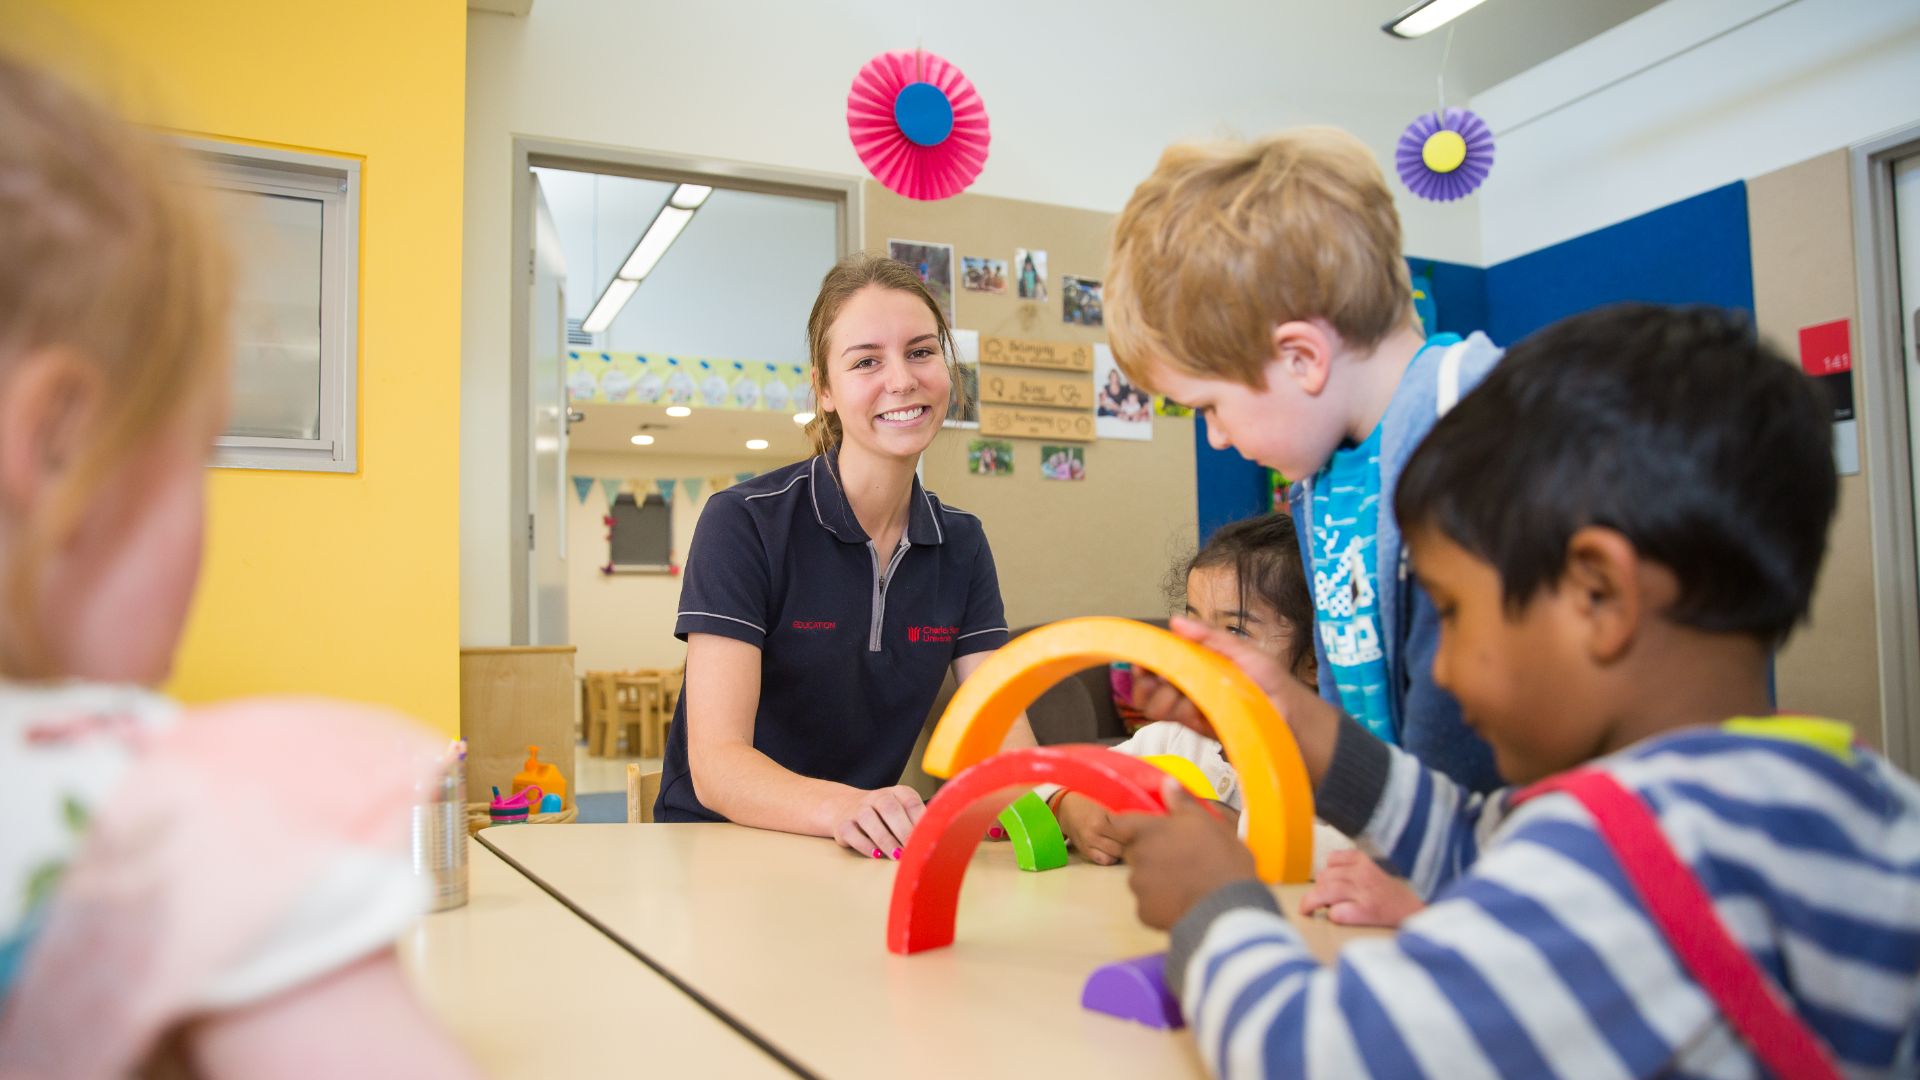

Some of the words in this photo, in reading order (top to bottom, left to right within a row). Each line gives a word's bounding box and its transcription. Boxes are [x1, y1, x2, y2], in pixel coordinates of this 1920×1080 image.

[1008, 340, 1055, 358] Belonging
[1823, 352, 1850, 371] 141
[792, 620, 836, 630] EDUCATION
